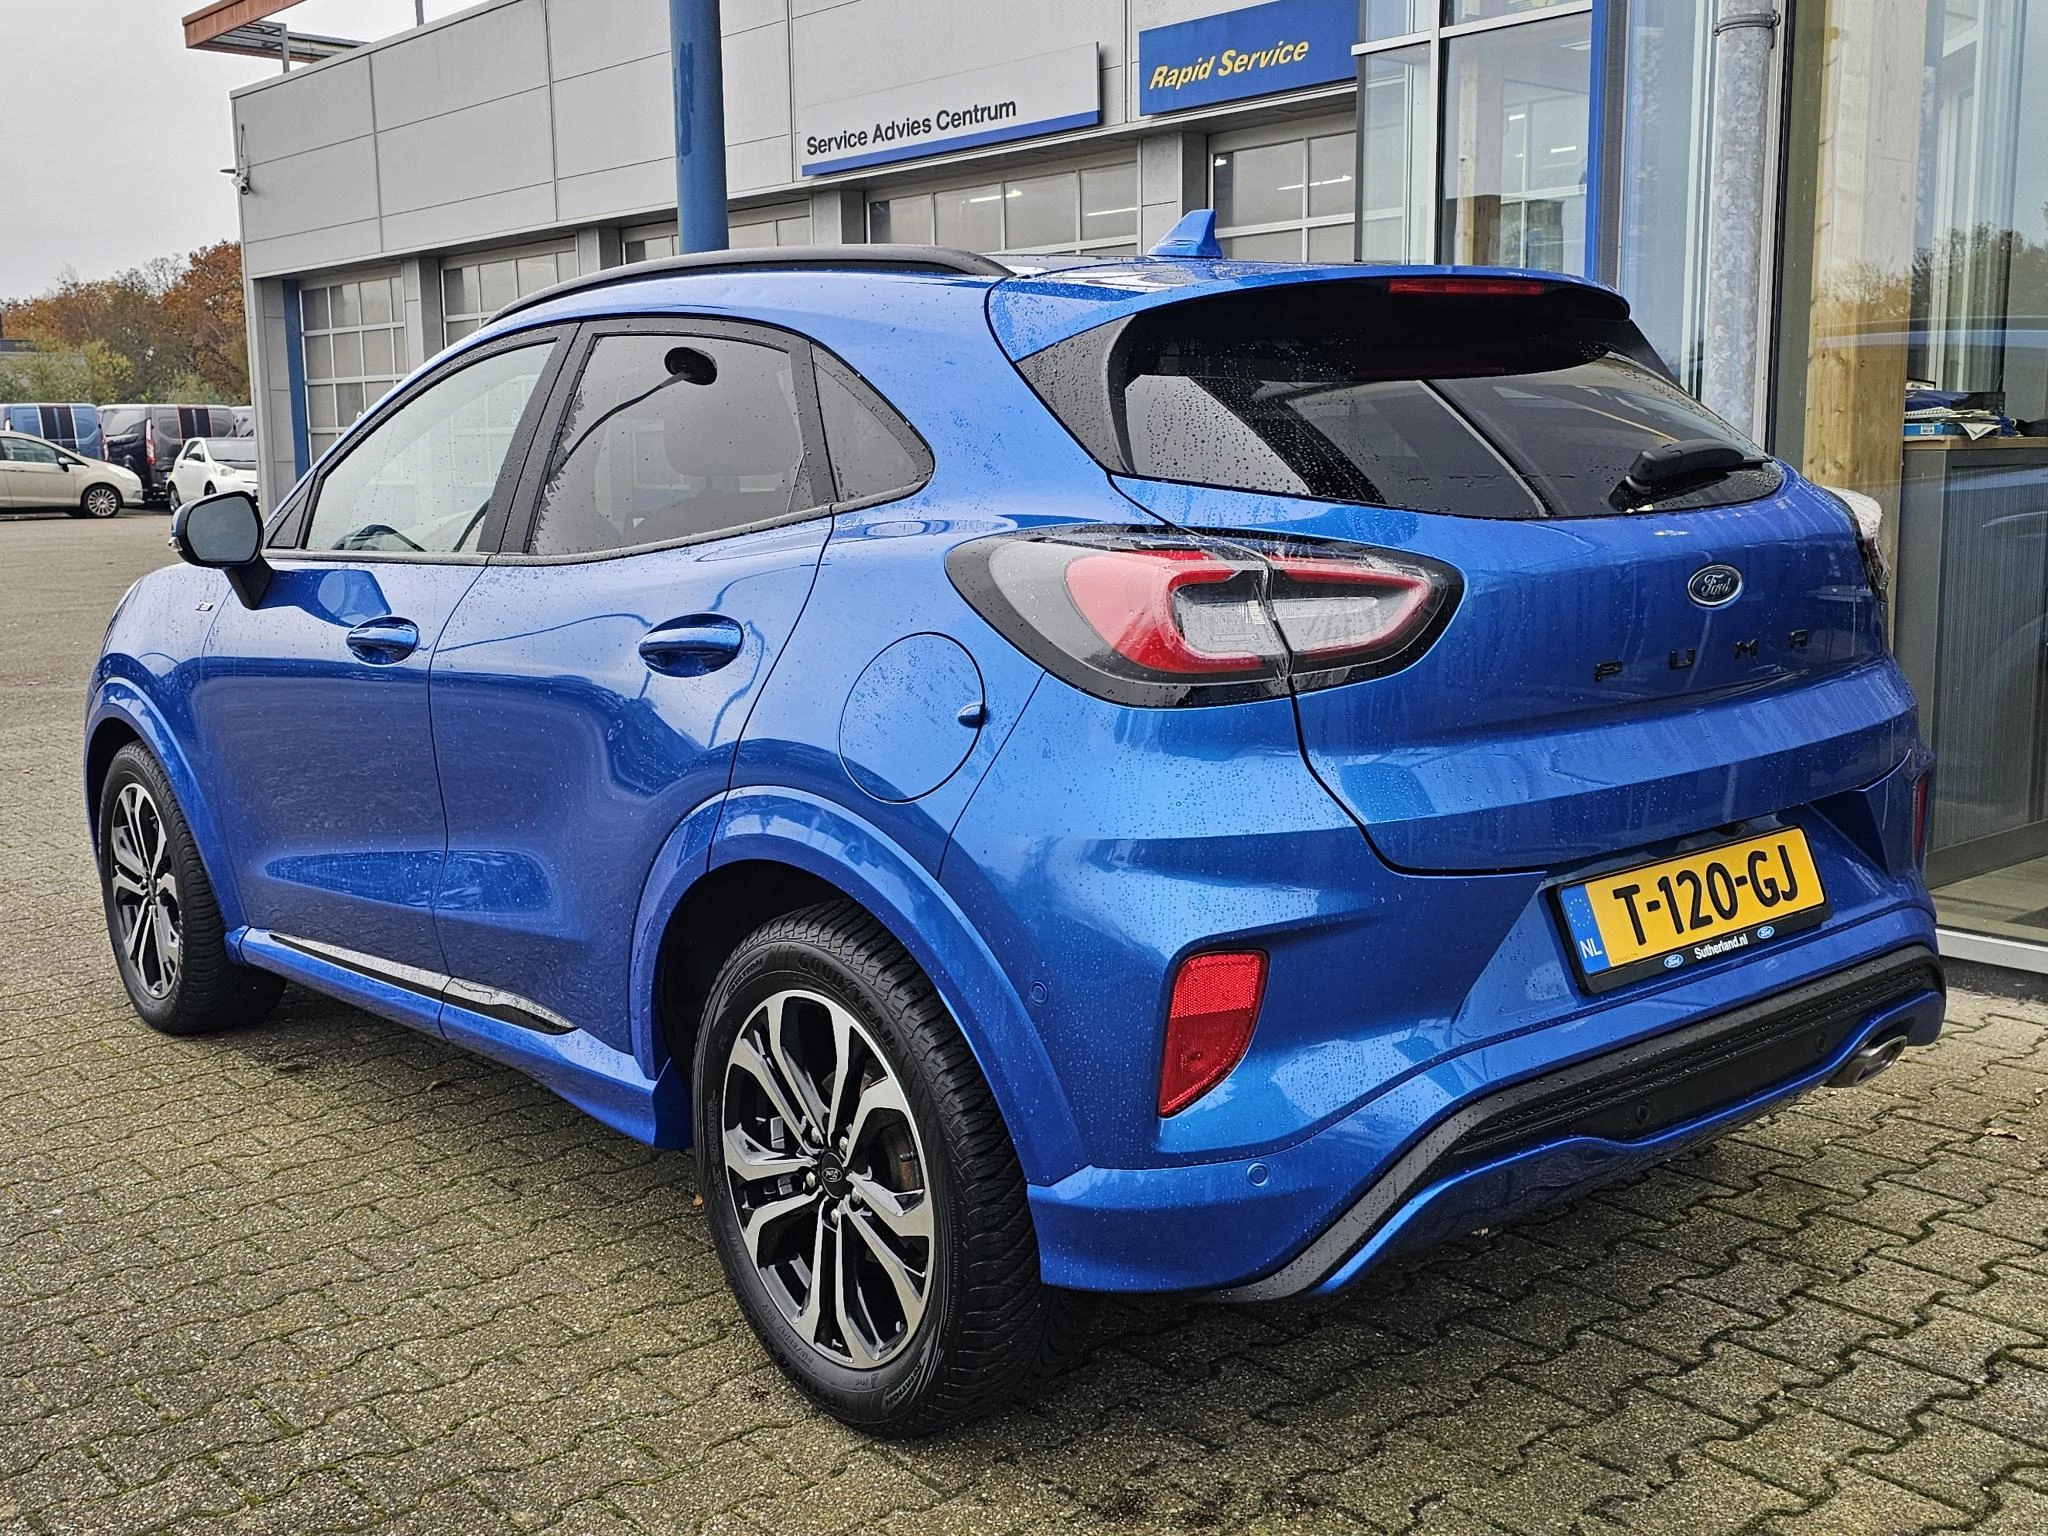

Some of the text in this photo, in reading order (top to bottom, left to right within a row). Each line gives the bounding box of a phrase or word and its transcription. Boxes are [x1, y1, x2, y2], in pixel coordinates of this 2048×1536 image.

[1149, 40, 1309, 90] Rapid Service
[806, 100, 1017, 156] Service Advies Centrum
[1594, 629, 1809, 683] PUMA
[1612, 844, 1799, 946] T-120-GJ
[1579, 939, 1602, 959] NL
[1694, 933, 1749, 960] Sutherland.nl
[799, 952, 898, 1052] GOODYEAR
